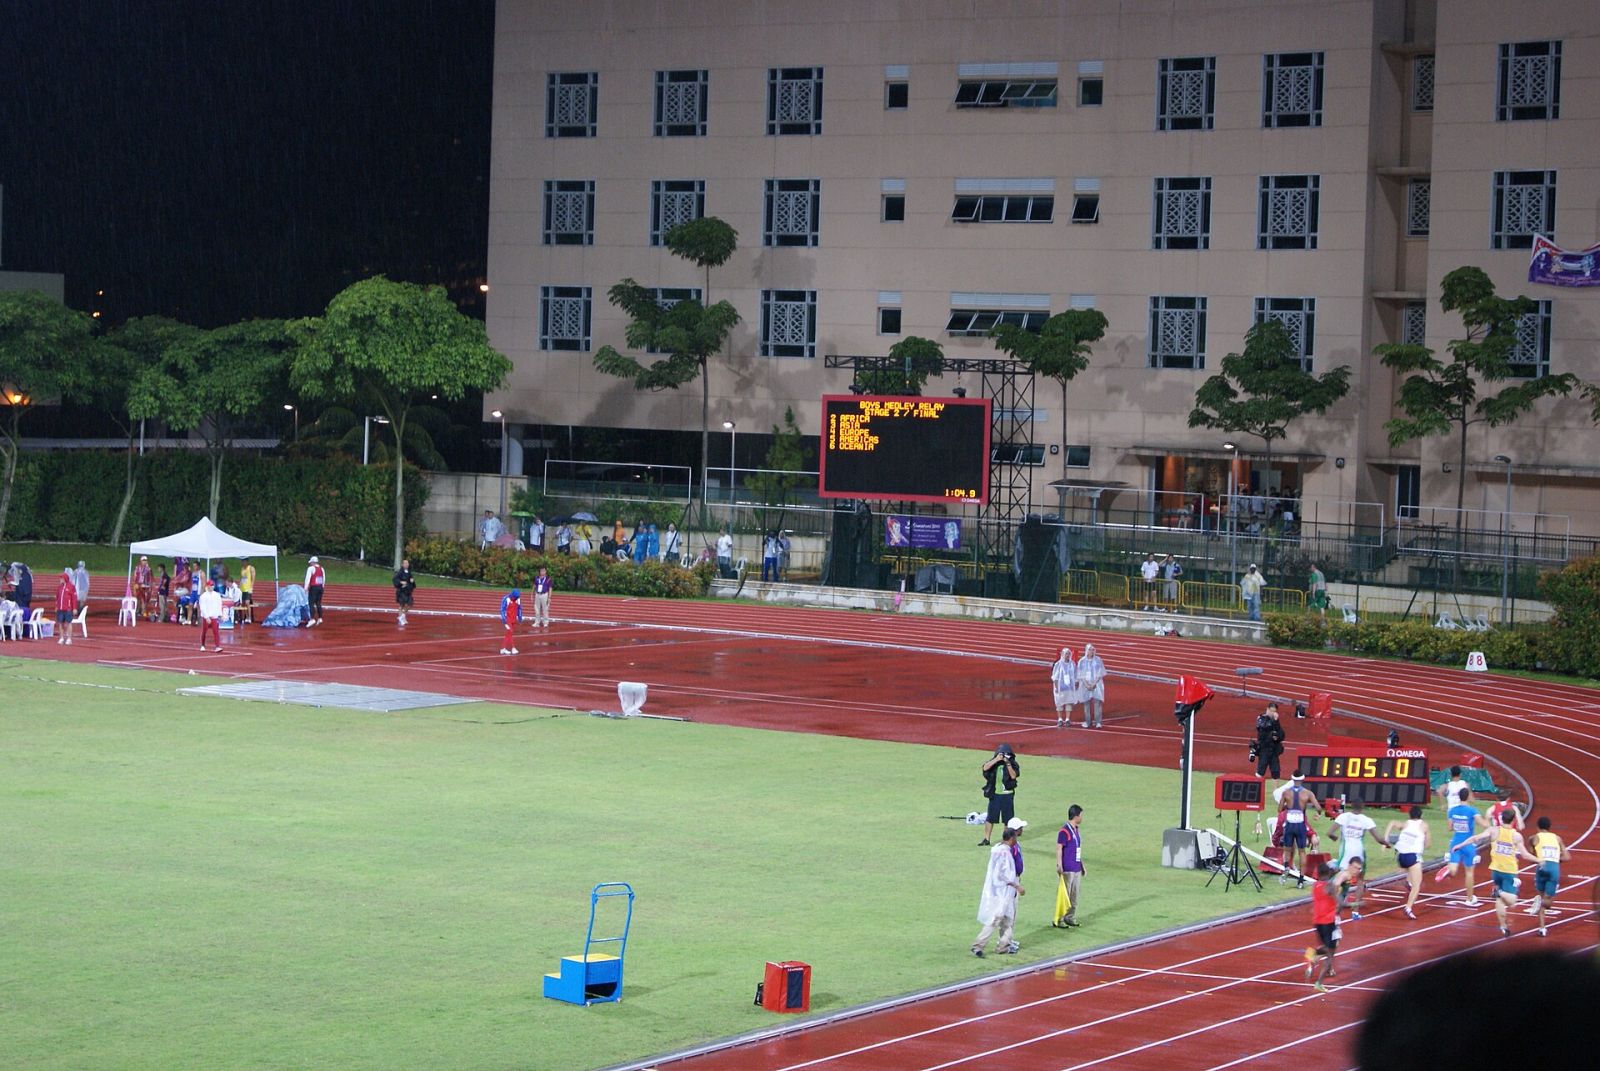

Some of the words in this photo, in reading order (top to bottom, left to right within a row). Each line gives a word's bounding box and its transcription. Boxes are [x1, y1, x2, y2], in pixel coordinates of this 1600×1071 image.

[860, 401, 880, 409] BOYS
[884, 402, 914, 410] MEDLEY
[919, 402, 944, 411] RELAY
[830, 414, 836, 422] 2
[914, 410, 939, 418] FINAL
[839, 436, 879, 444] AMERICAS
[945, 489, 975, 497] 1:04.9
[1477, 655, 1482, 665] 8
[1321, 757, 1410, 778] 1:05.0
